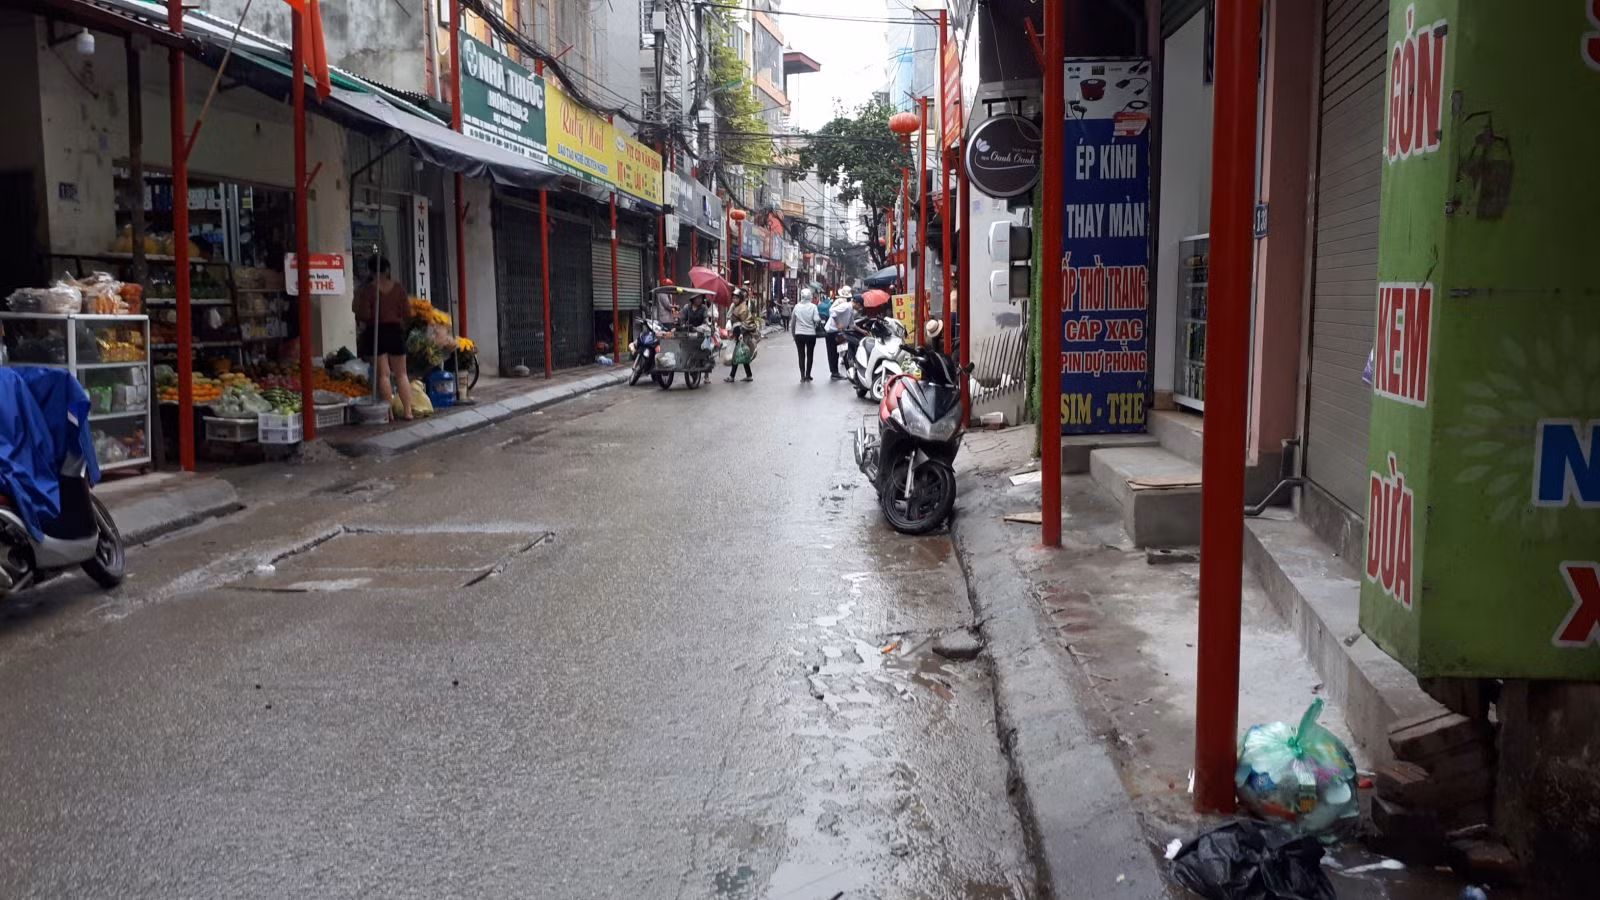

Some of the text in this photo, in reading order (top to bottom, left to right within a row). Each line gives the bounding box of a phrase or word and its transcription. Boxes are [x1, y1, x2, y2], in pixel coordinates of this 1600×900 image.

[477, 52, 544, 109] NHÀ THUỐC
[1075, 137, 1137, 180] ÉP KÍNH
[1066, 195, 1145, 238] THAY MÀN
[1106, 265, 1148, 311] TRANG
[1104, 318, 1143, 346] XẠC
[1374, 282, 1434, 408] KEM
[1061, 346, 1148, 378] PIN DỰ PHÒNG
[1061, 393, 1092, 424] SIM
[1107, 380, 1145, 425] THẺ
[1365, 450, 1414, 610] DỪA
